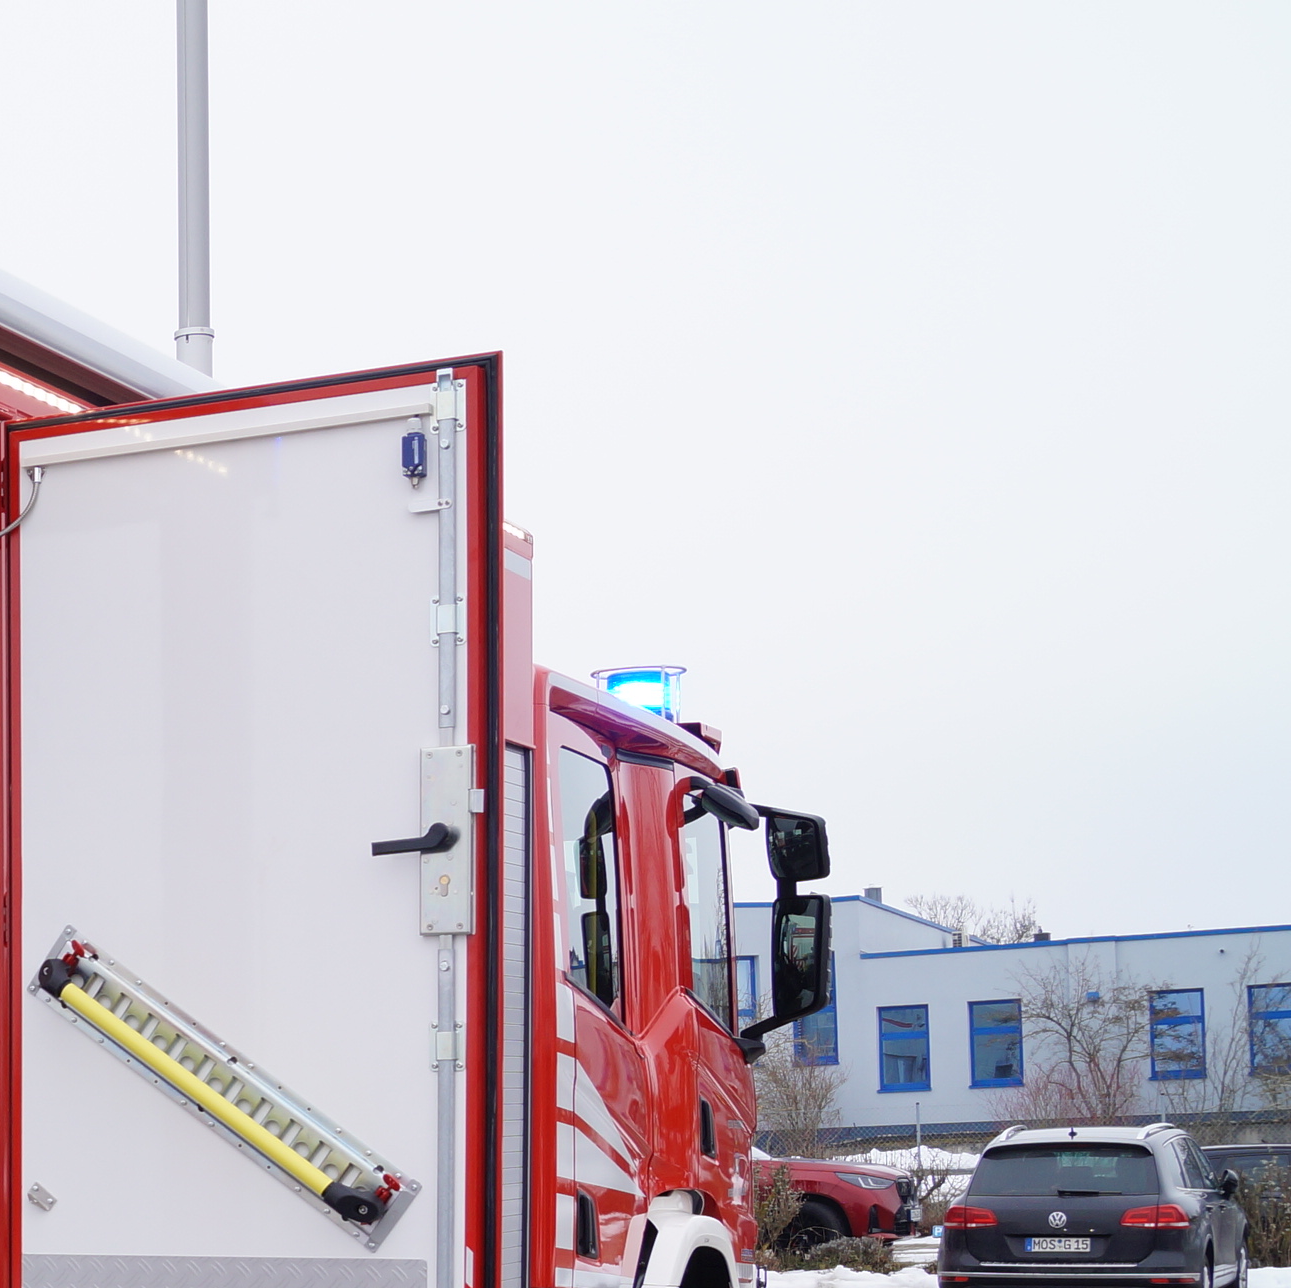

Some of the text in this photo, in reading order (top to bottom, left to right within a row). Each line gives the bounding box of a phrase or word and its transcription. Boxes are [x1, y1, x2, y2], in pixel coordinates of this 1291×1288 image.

[1033, 1239, 1089, 1250] MOS G 15
